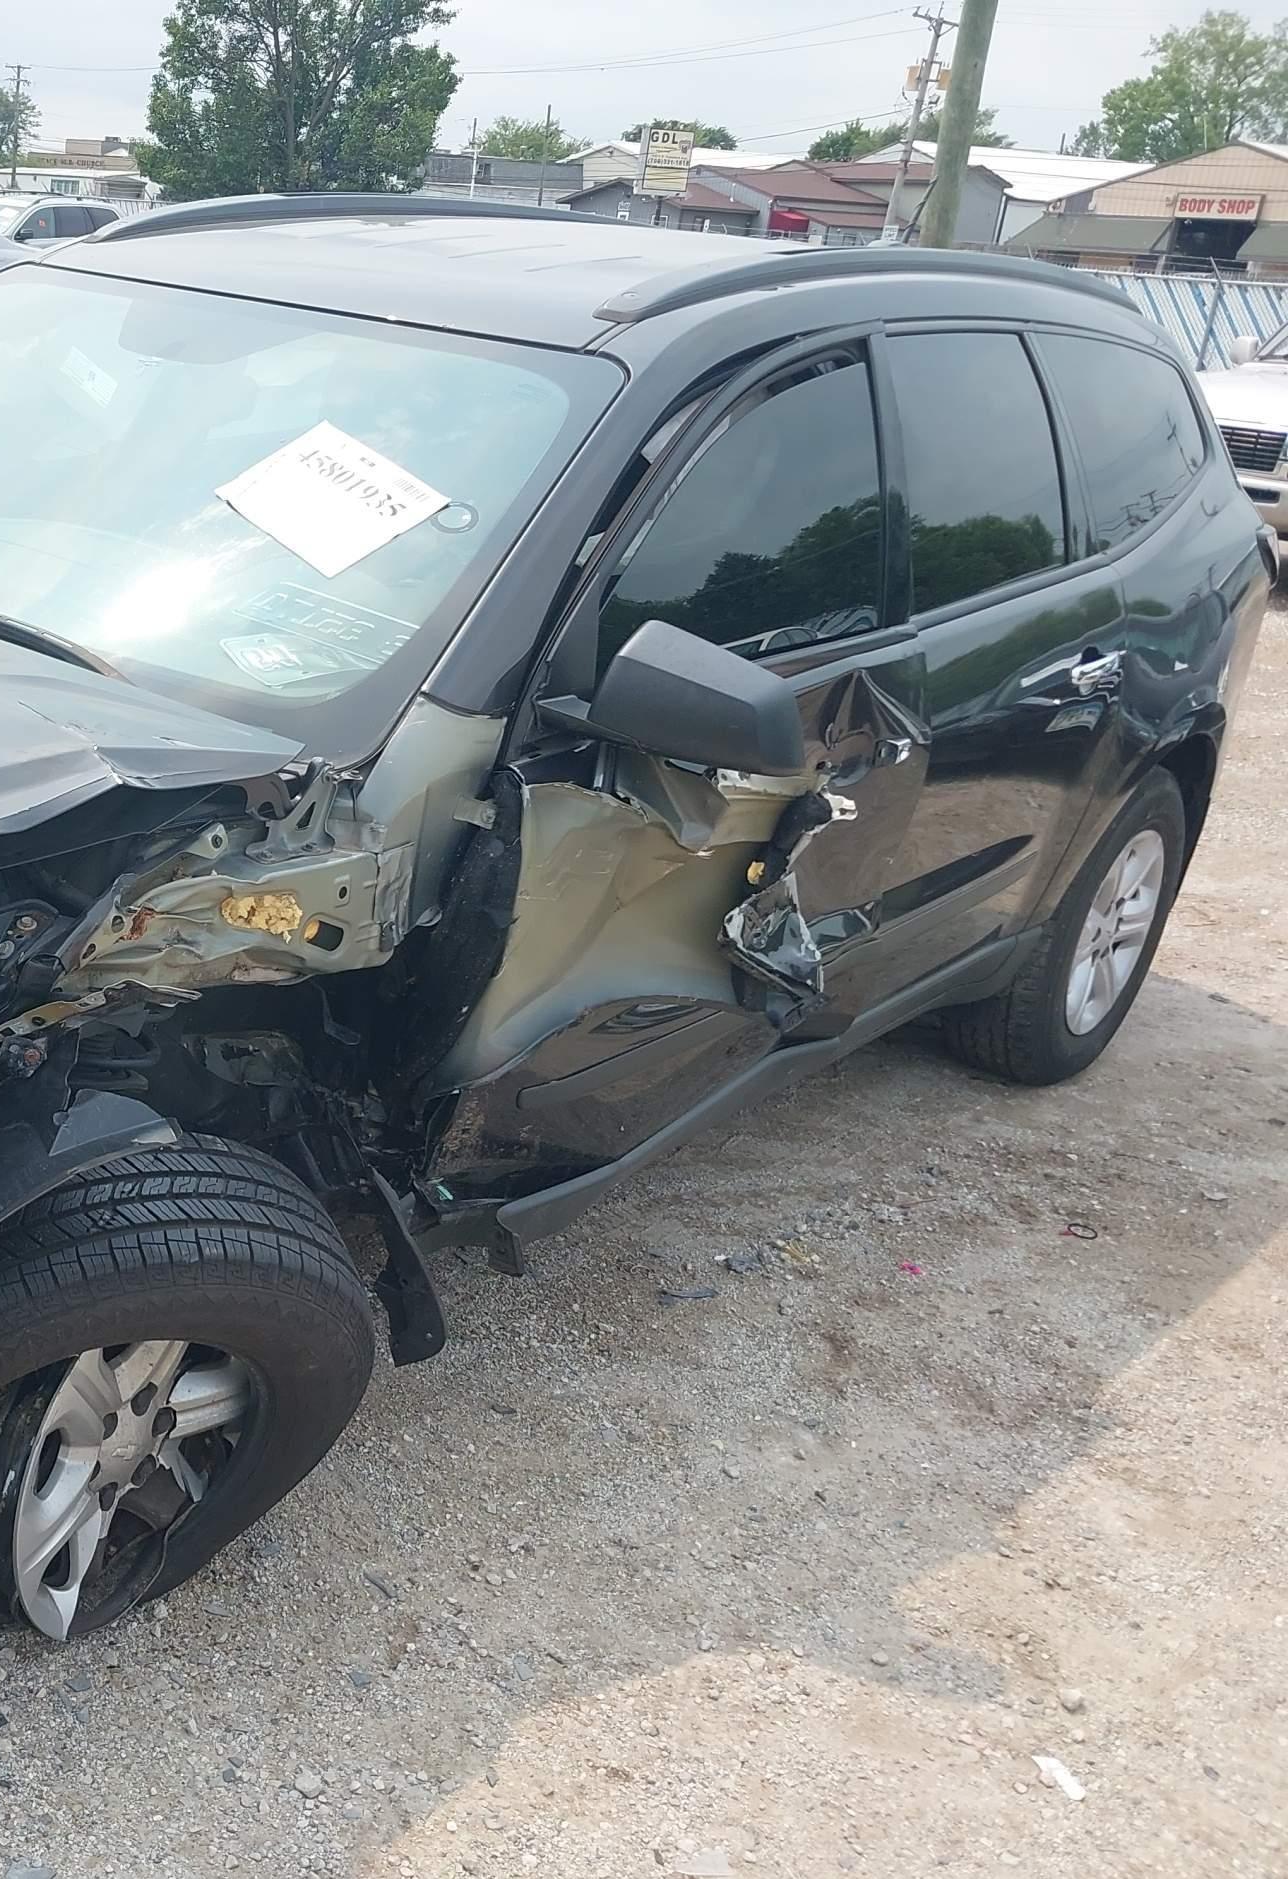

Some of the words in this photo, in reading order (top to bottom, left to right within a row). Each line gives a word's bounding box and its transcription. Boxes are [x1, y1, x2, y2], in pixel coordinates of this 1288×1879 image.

[651, 131, 678, 144] GDL
[1178, 197, 1216, 213] BODY
[1217, 198, 1256, 215] SHOP
